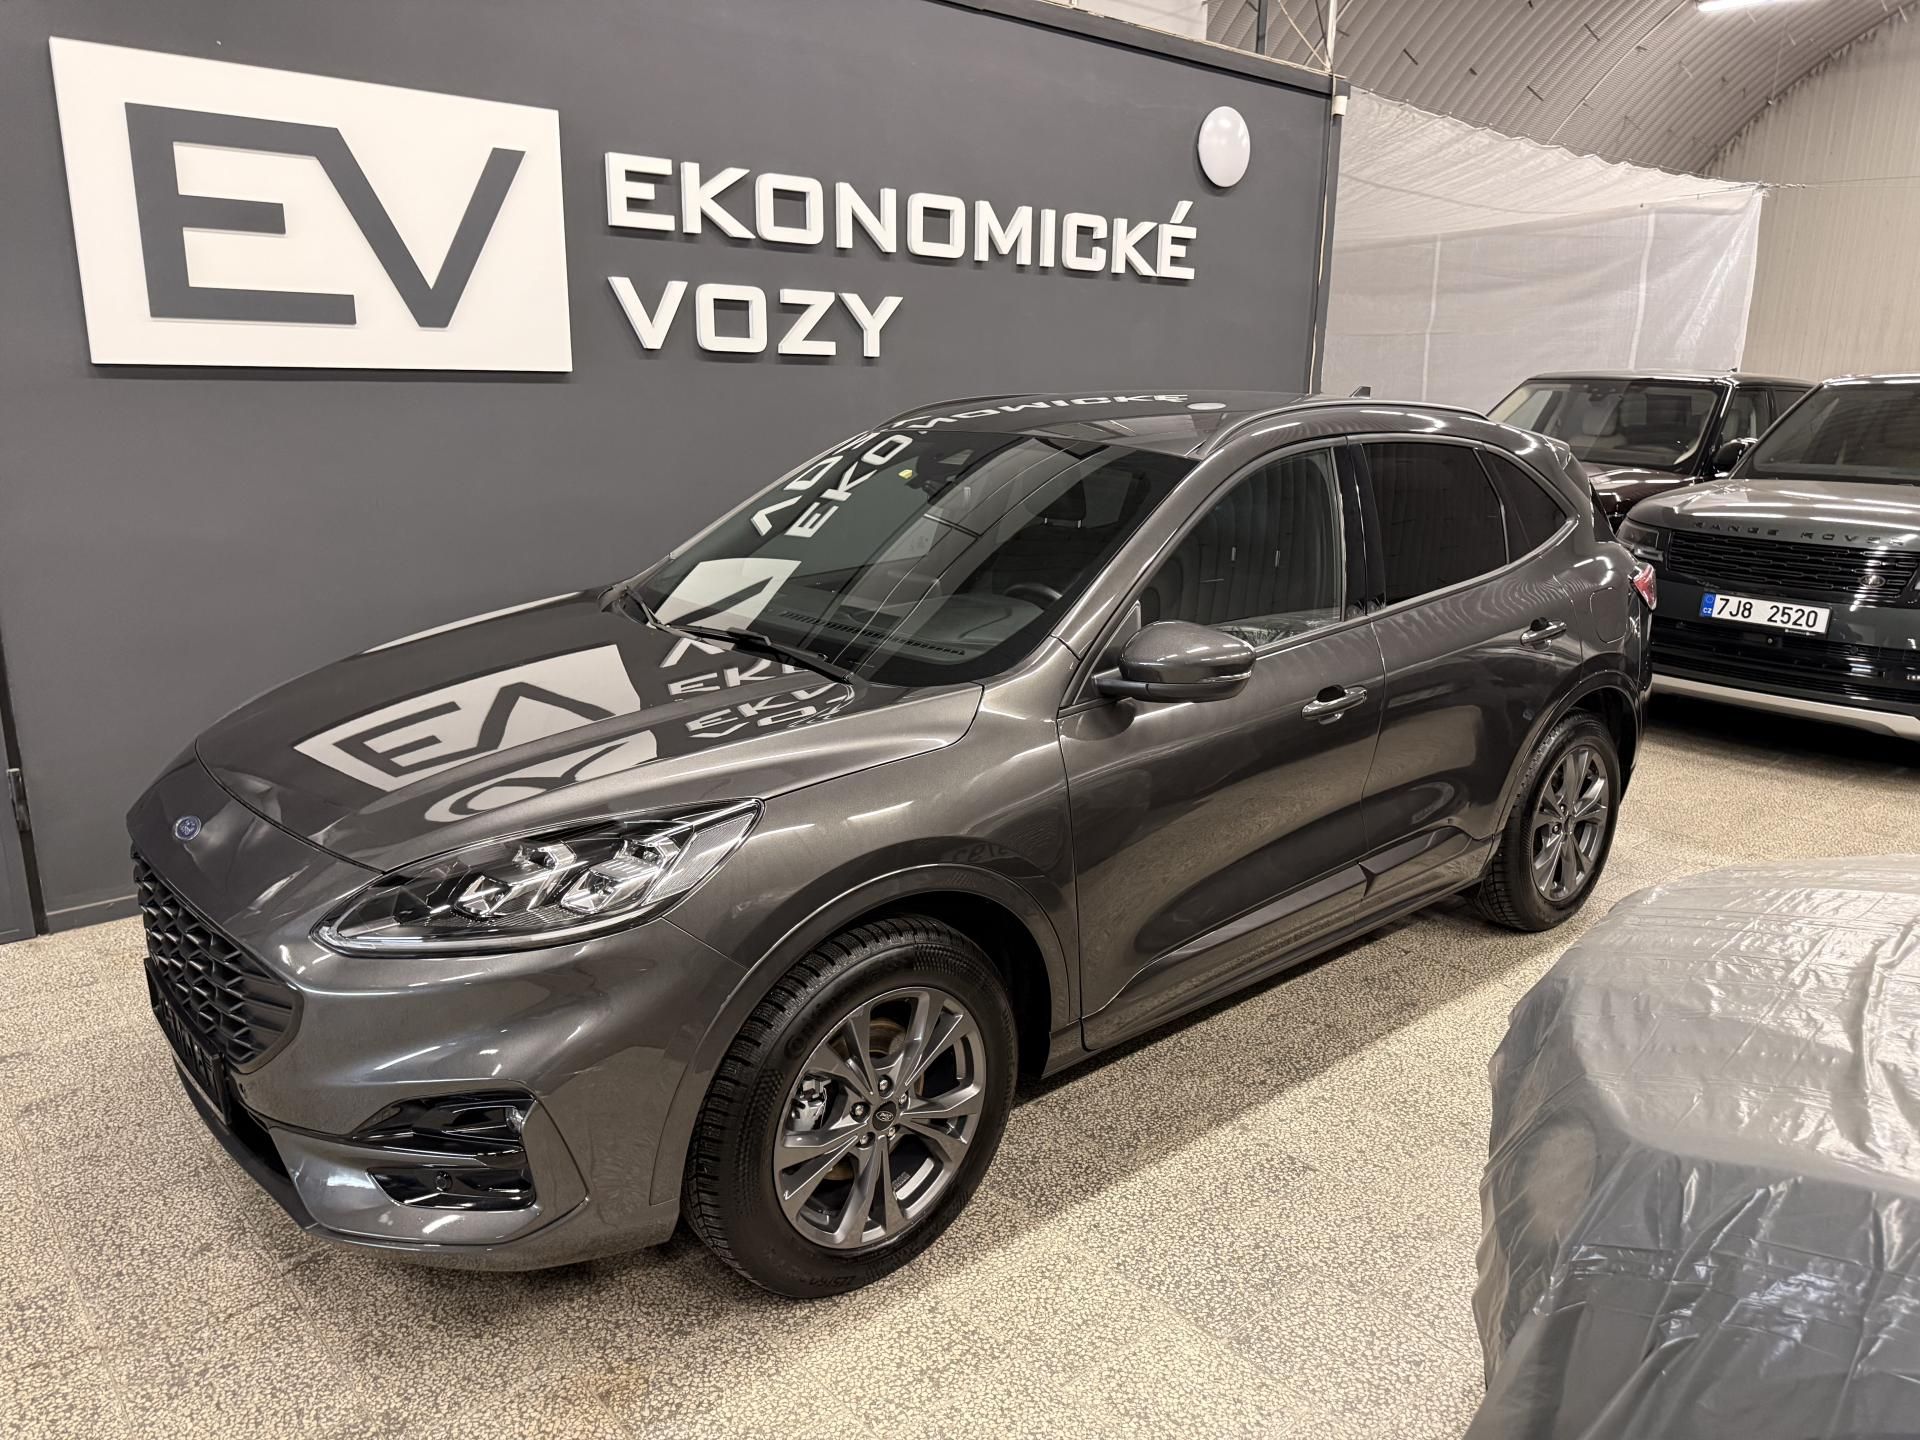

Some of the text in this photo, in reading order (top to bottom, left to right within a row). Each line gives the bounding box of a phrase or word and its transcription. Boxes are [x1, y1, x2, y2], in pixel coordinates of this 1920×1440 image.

[125, 102, 526, 328] EV
[604, 151, 1197, 280] EKONOMICKÉ
[608, 276, 903, 358] VOZY
[1716, 598, 1818, 628] 7J8 2520
